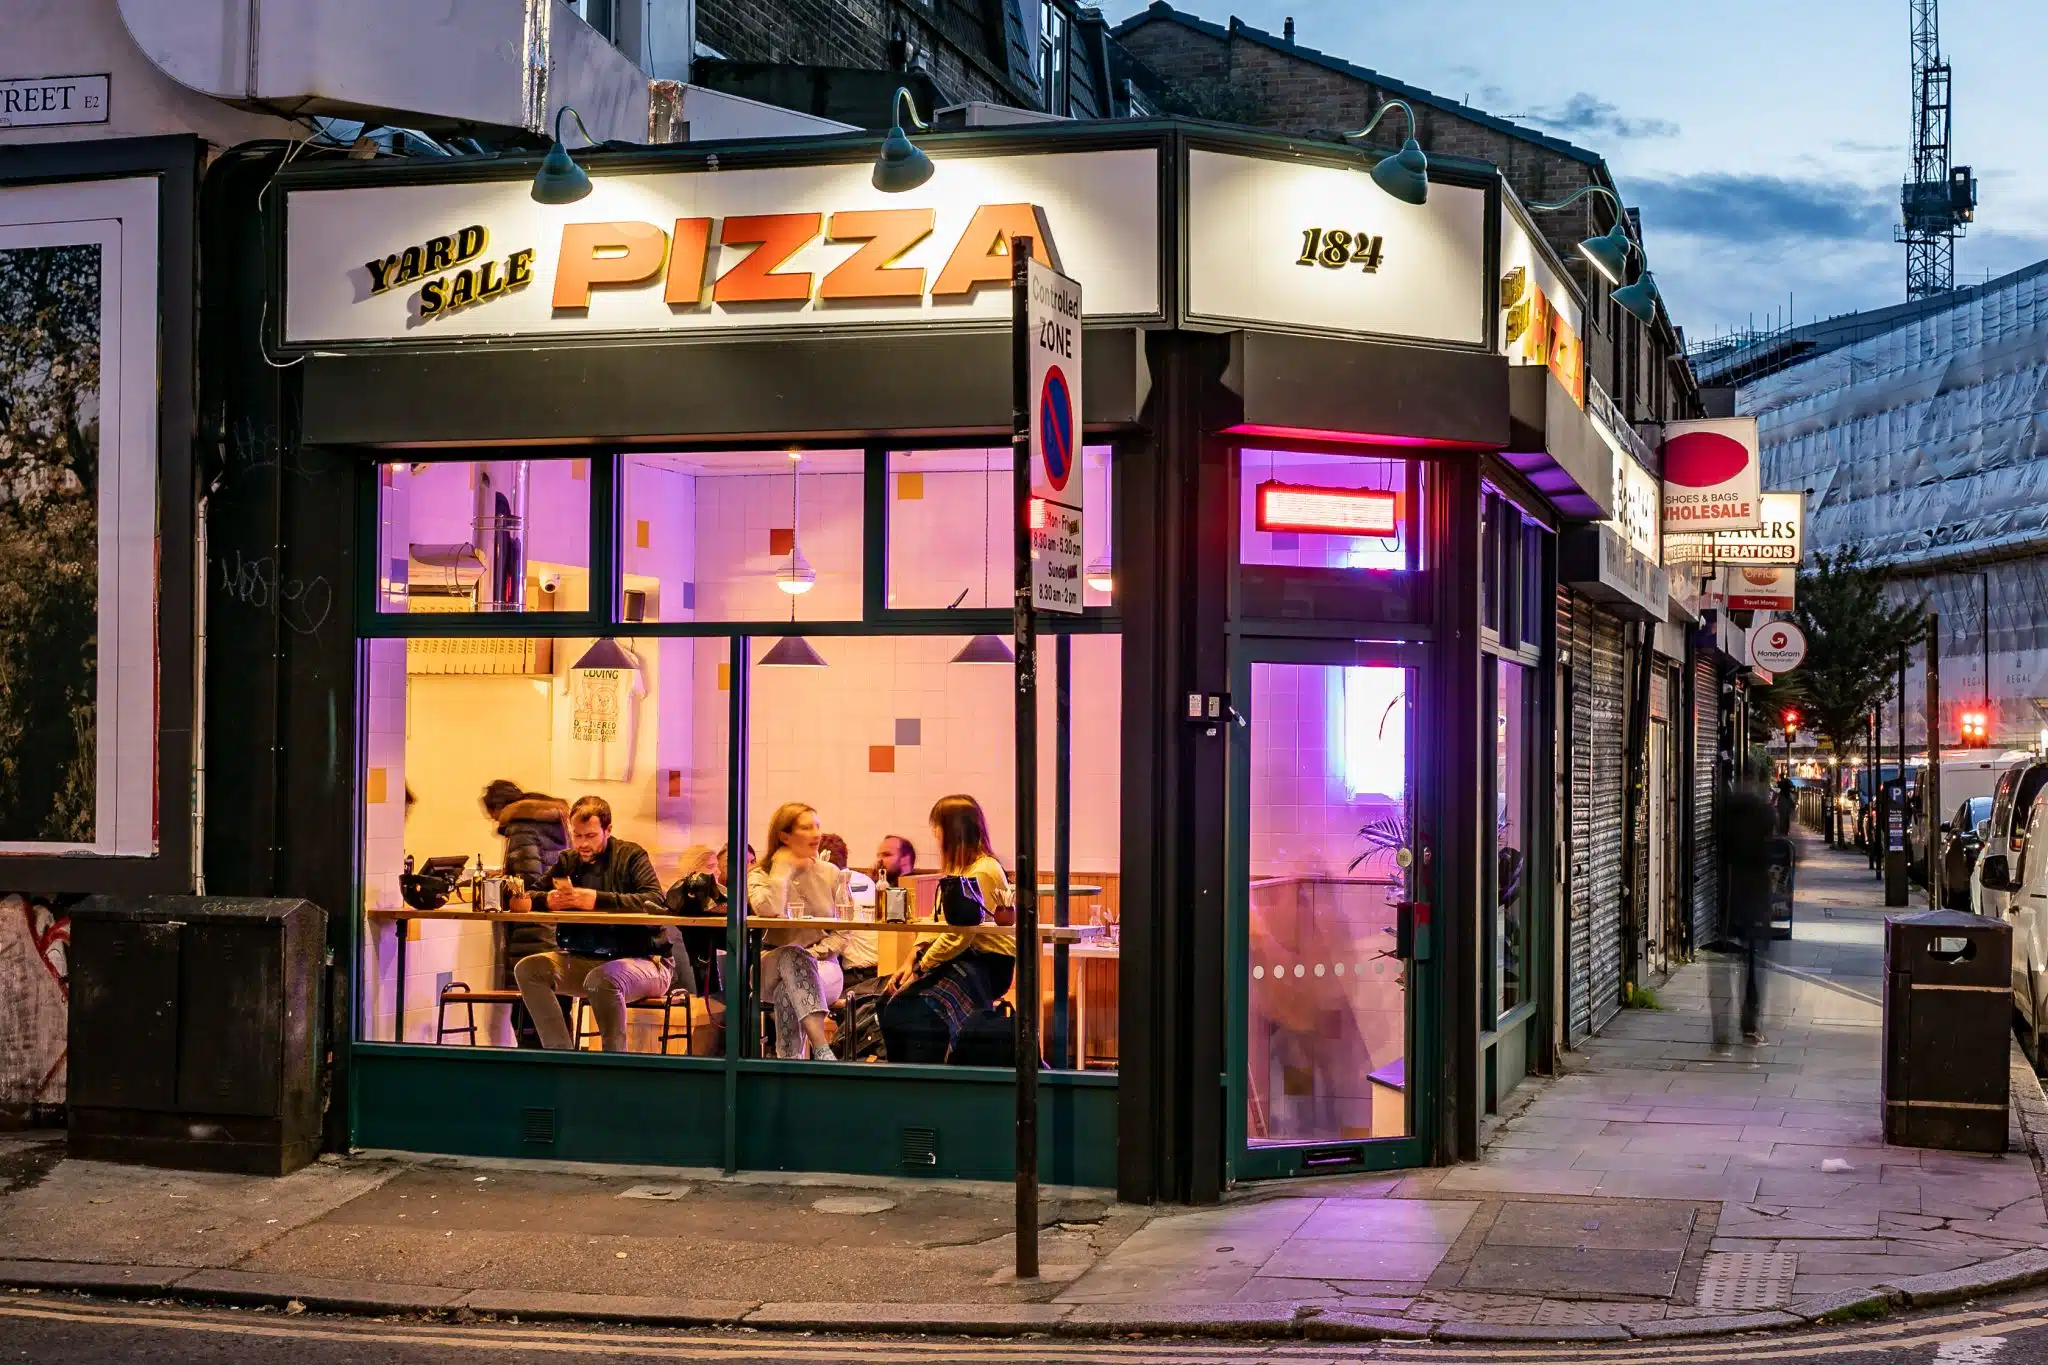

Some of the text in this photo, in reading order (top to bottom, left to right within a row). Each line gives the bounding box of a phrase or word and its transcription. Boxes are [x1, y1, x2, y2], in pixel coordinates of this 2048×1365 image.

[0, 86, 100, 113] REET E2
[365, 224, 490, 295] YARD
[552, 203, 1053, 309] PIZZA
[1296, 227, 1384, 274] 184
[420, 248, 536, 318] SALE
[1032, 275, 1079, 320] Controlled
[1039, 316, 1072, 359] ZONE
[1664, 492, 1738, 505] SHOES & BAGS
[1048, 561, 1067, 583] Sunday
[1745, 569, 1777, 579] OFFICE
[1757, 650, 1800, 658] MoneyGram
[583, 669, 619, 680] LOVING
[1962, 674, 2032, 687] REGAL REGAL
[1892, 787, 1902, 801] P
